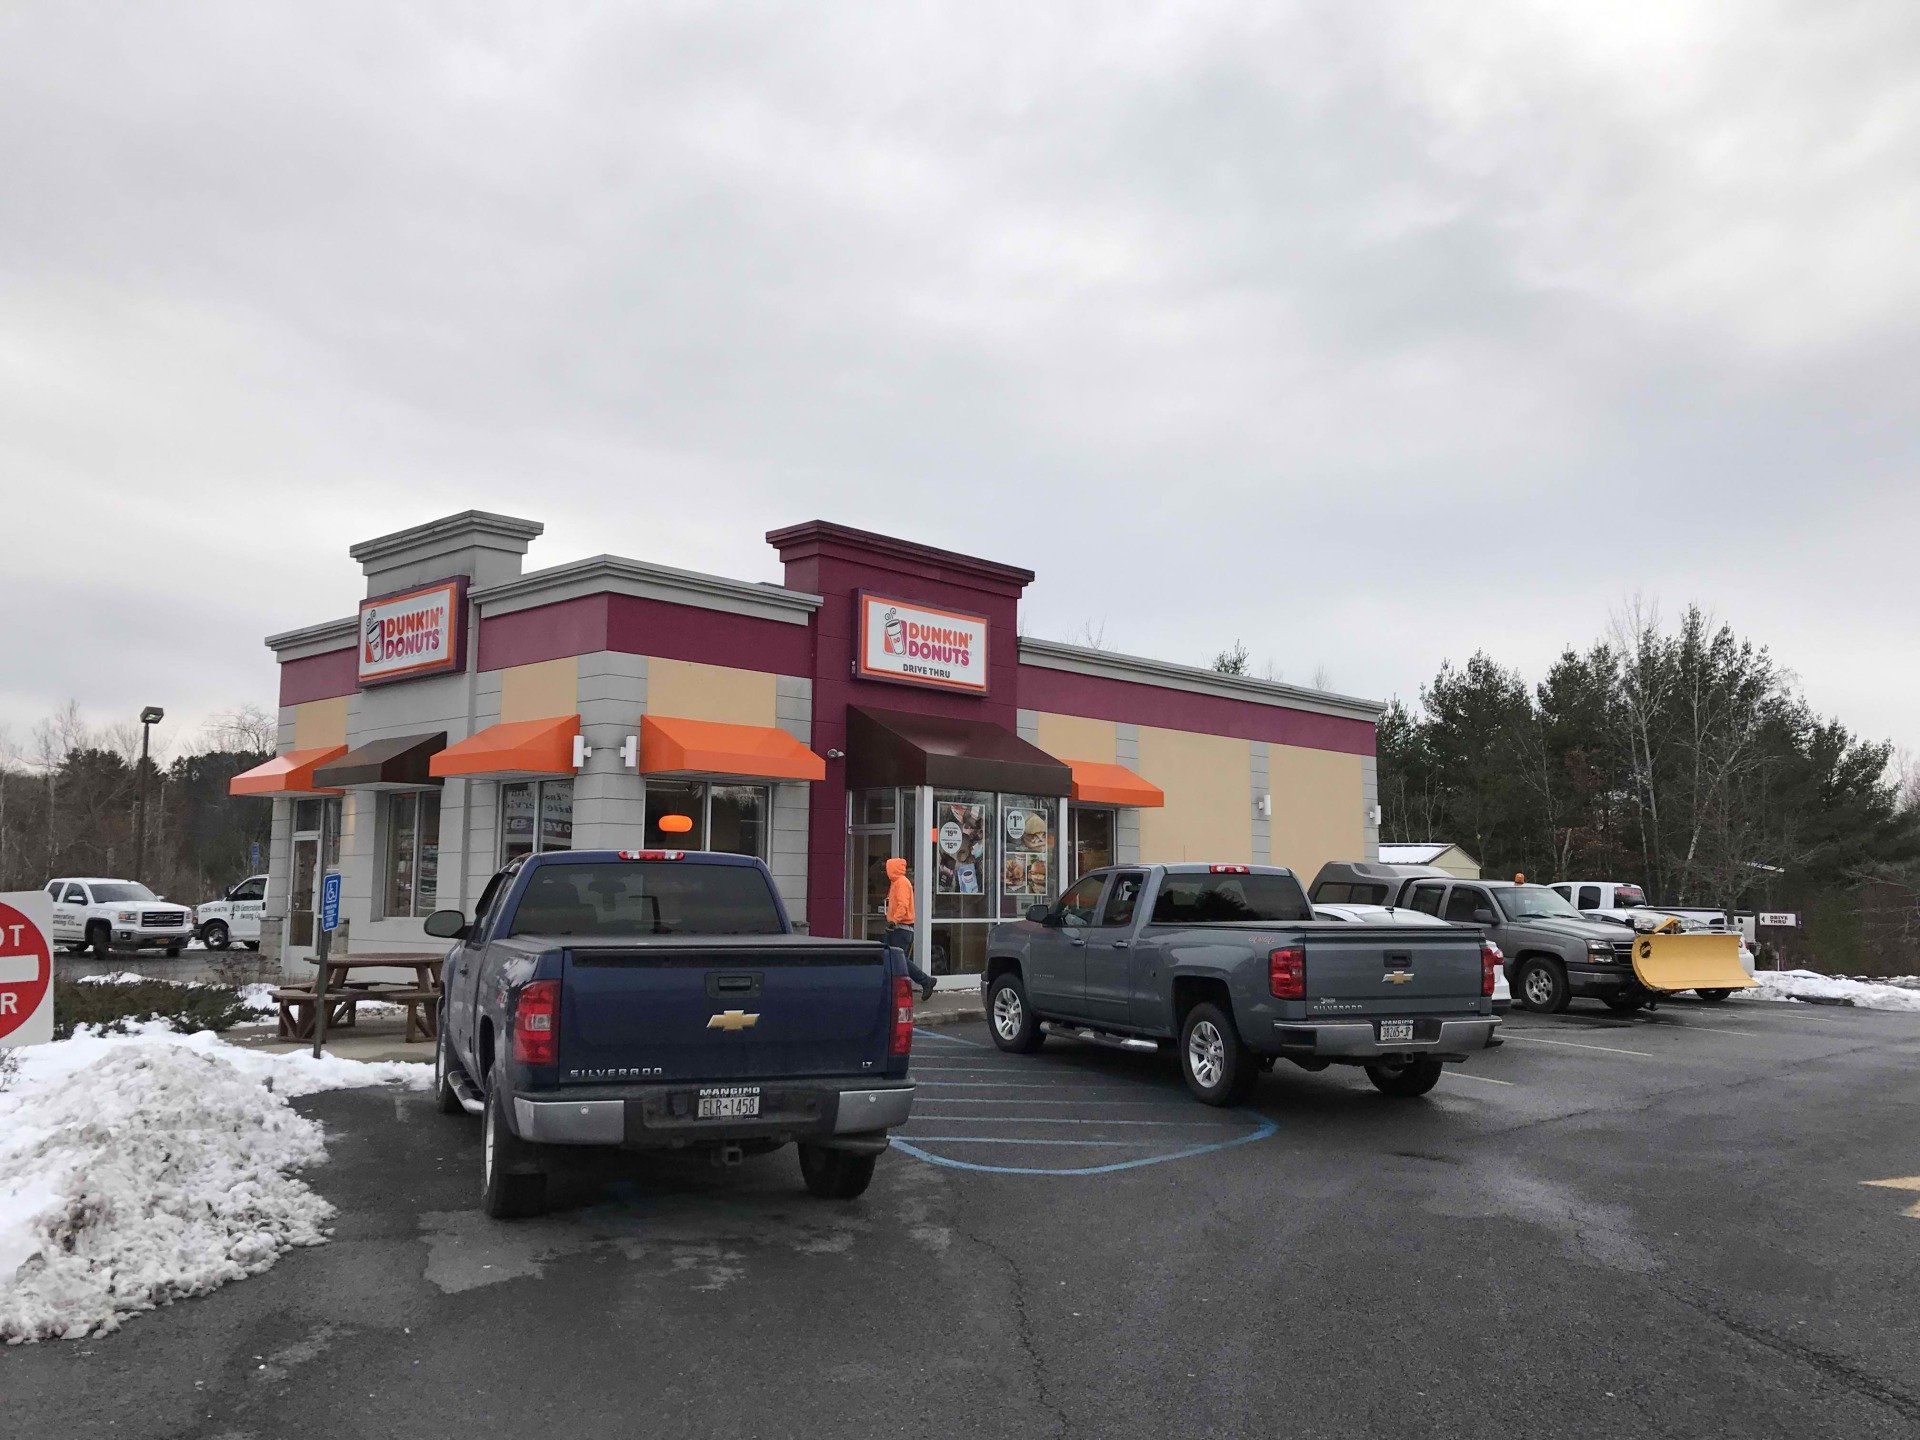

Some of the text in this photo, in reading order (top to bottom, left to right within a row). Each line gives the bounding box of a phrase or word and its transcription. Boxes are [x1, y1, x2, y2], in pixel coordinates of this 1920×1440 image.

[386, 606, 443, 638] DUNKIN'
[908, 622, 972, 648] DUNKIN'
[385, 628, 439, 659] DONUTS
[908, 640, 969, 666] DONUTS
[903, 663, 951, 678] DRIVE THRU
[569, 1067, 662, 1078] SILVERADO
[700, 1086, 760, 1096] MANGINO
